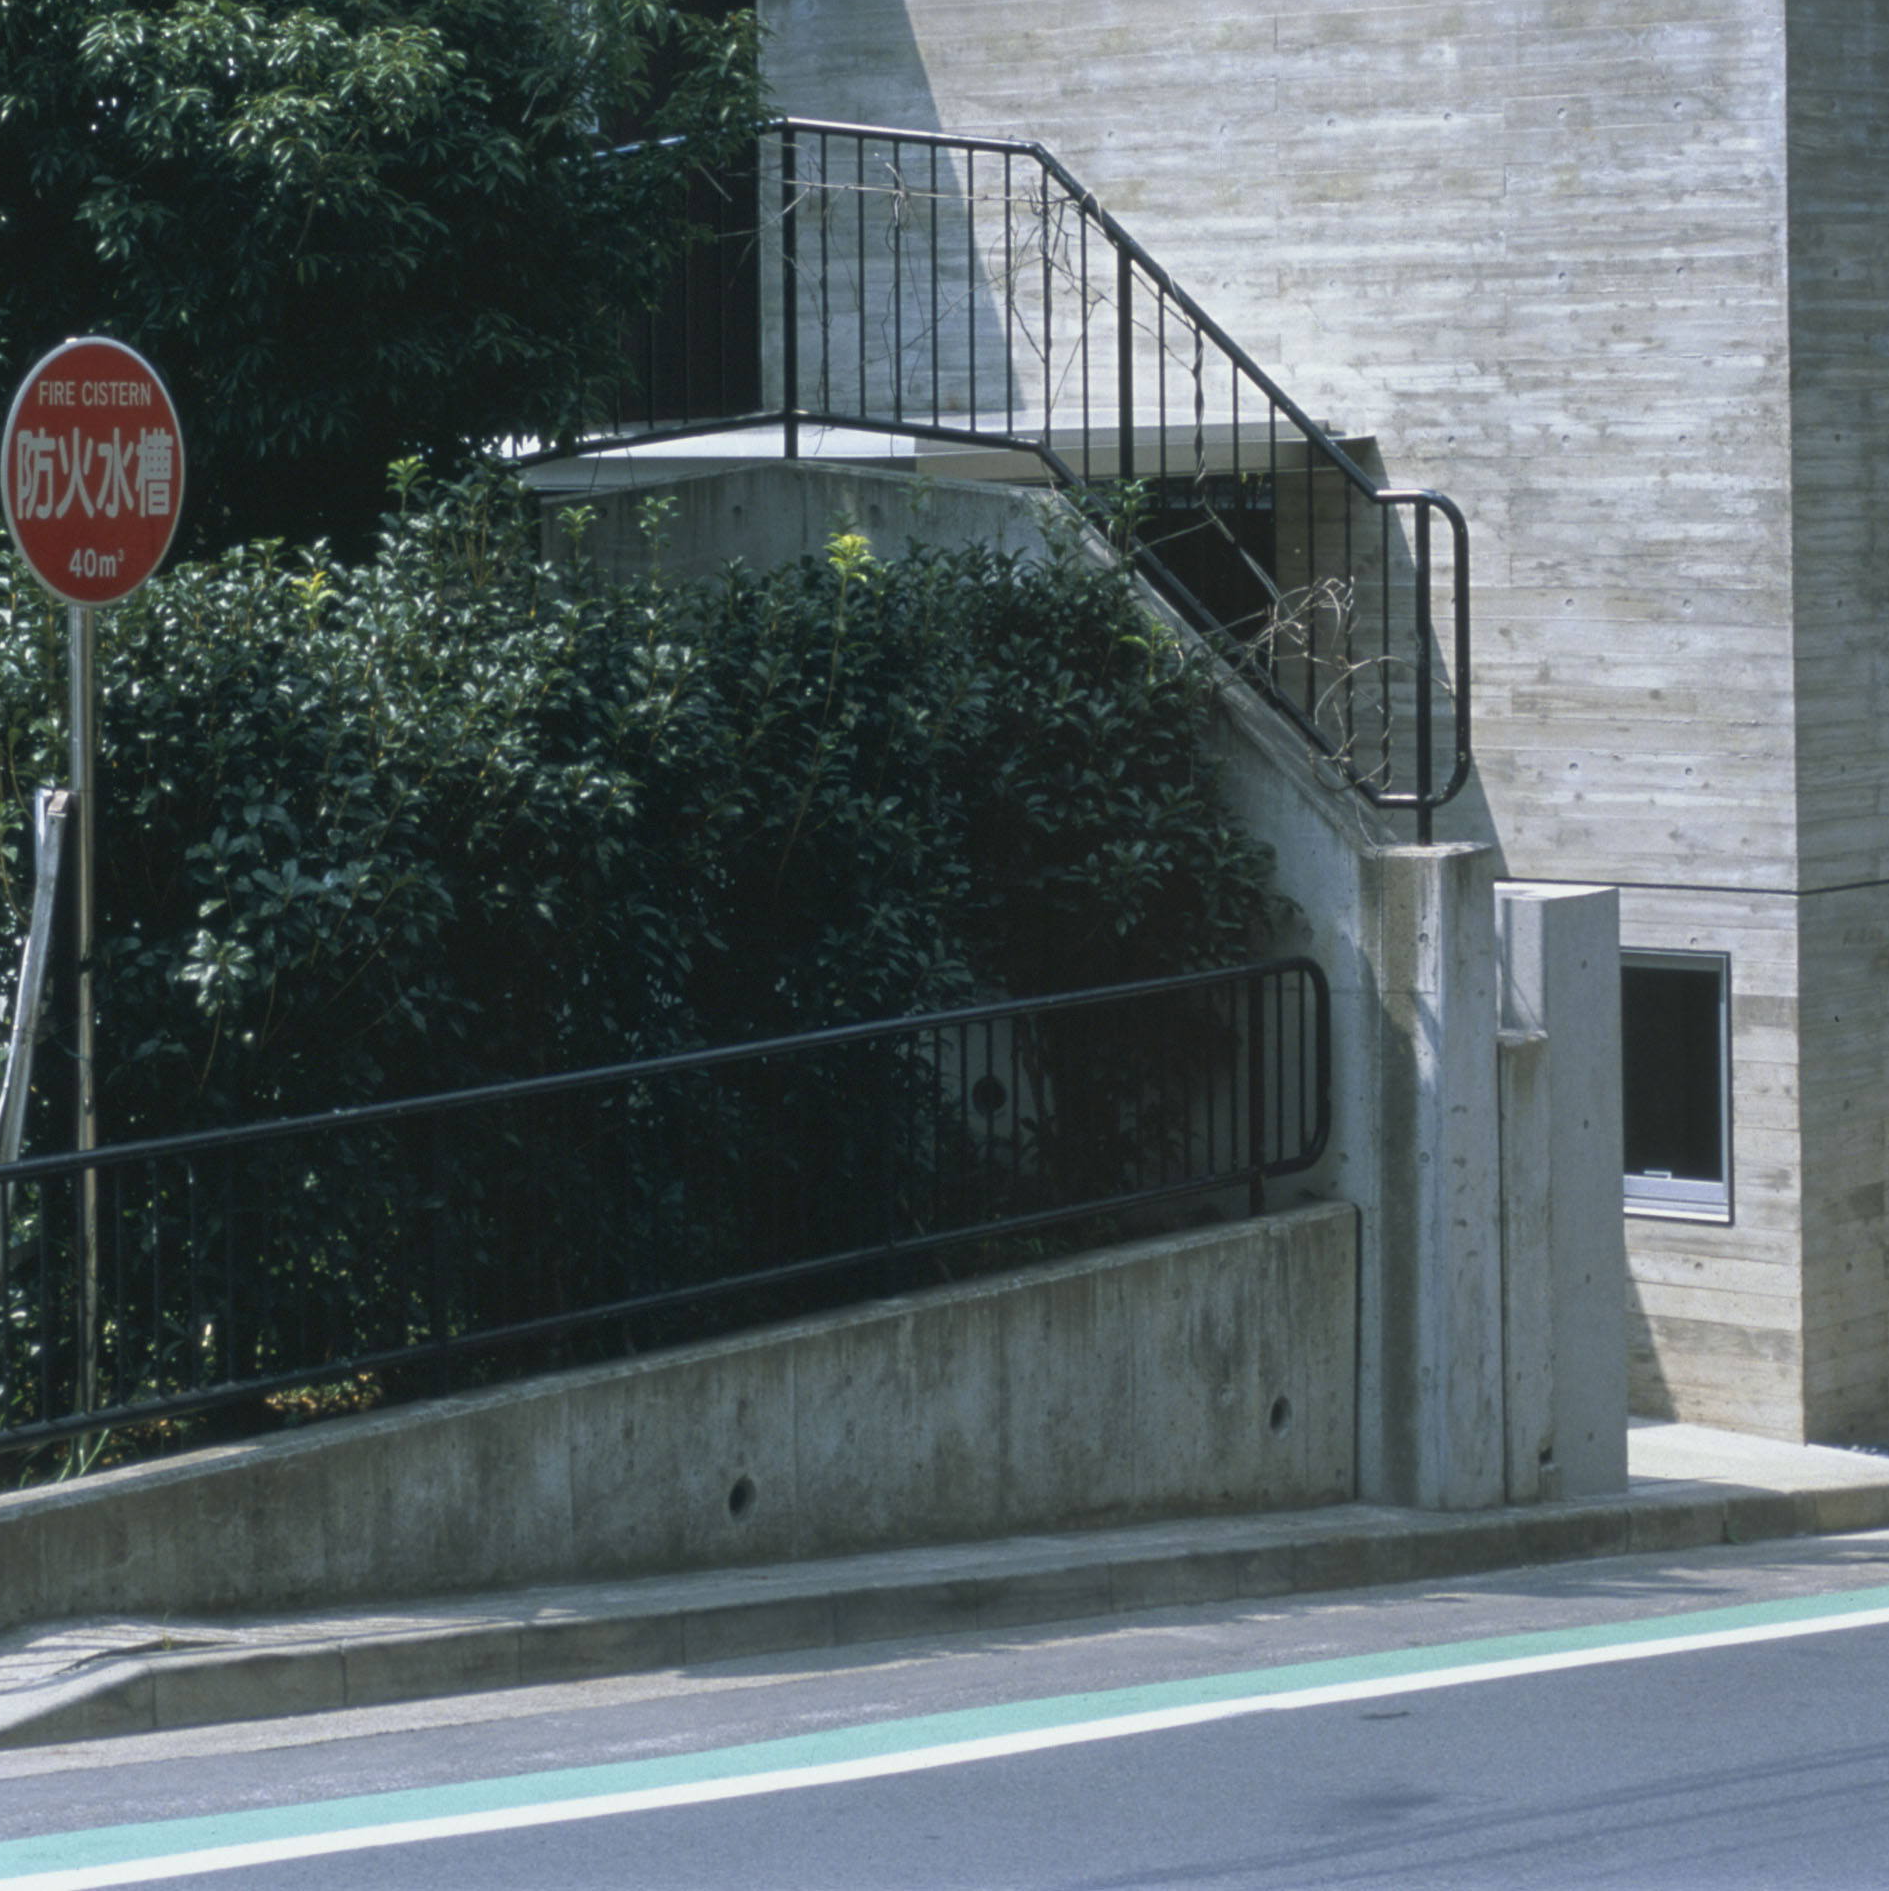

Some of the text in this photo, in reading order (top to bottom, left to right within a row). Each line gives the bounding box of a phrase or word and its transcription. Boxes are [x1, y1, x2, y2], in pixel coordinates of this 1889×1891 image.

[38, 381, 152, 407] FIRE CISTERN
[17, 427, 173, 519] 防火水槽
